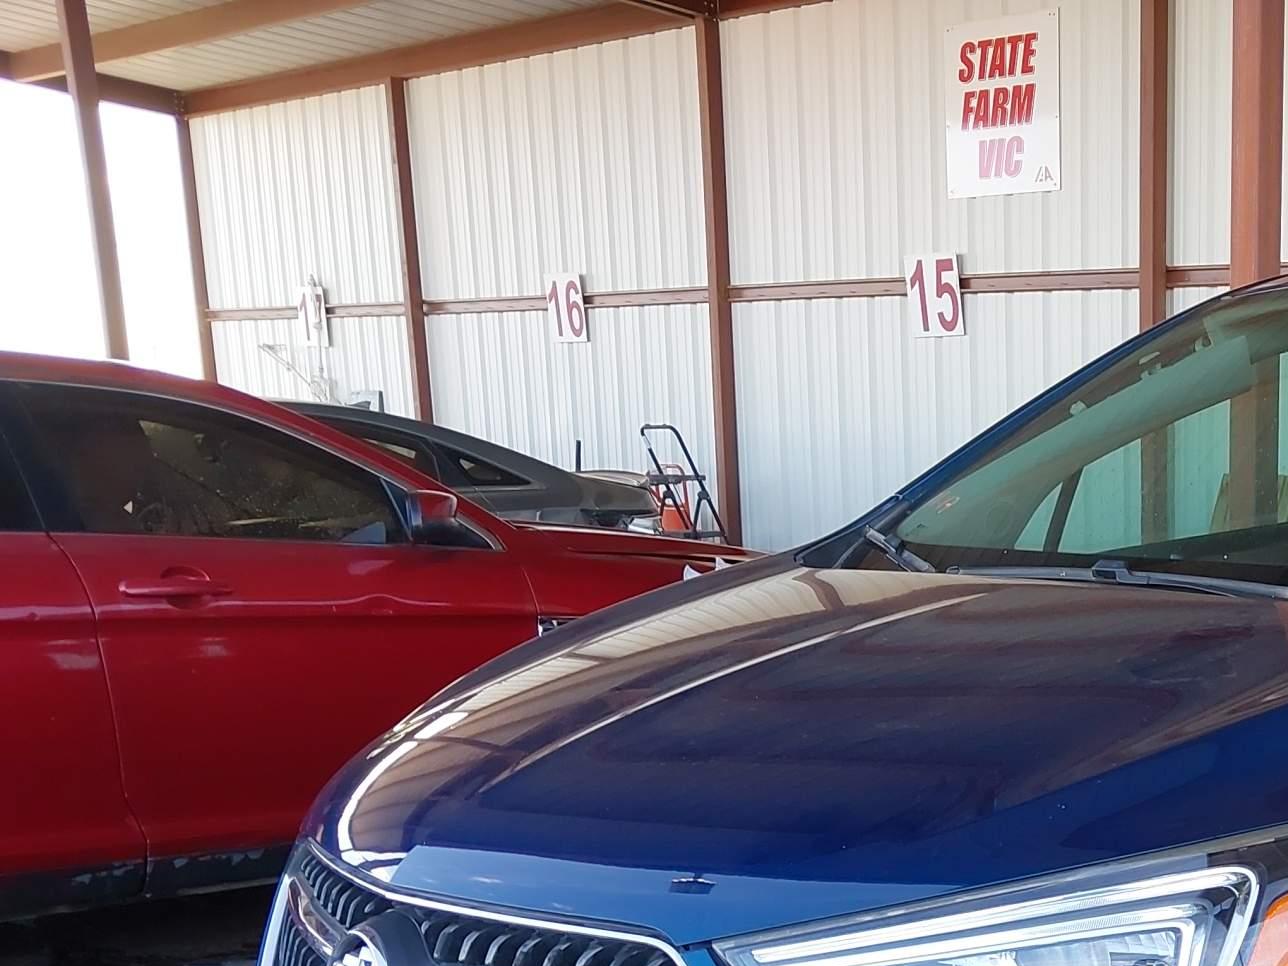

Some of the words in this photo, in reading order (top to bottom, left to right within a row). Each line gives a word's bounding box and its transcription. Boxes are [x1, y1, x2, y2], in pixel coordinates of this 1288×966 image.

[959, 32, 1038, 83] STATE
[961, 83, 1036, 131] FARM
[978, 136, 1025, 179] VIC
[548, 280, 583, 337] 16
[910, 258, 959, 333] 15
